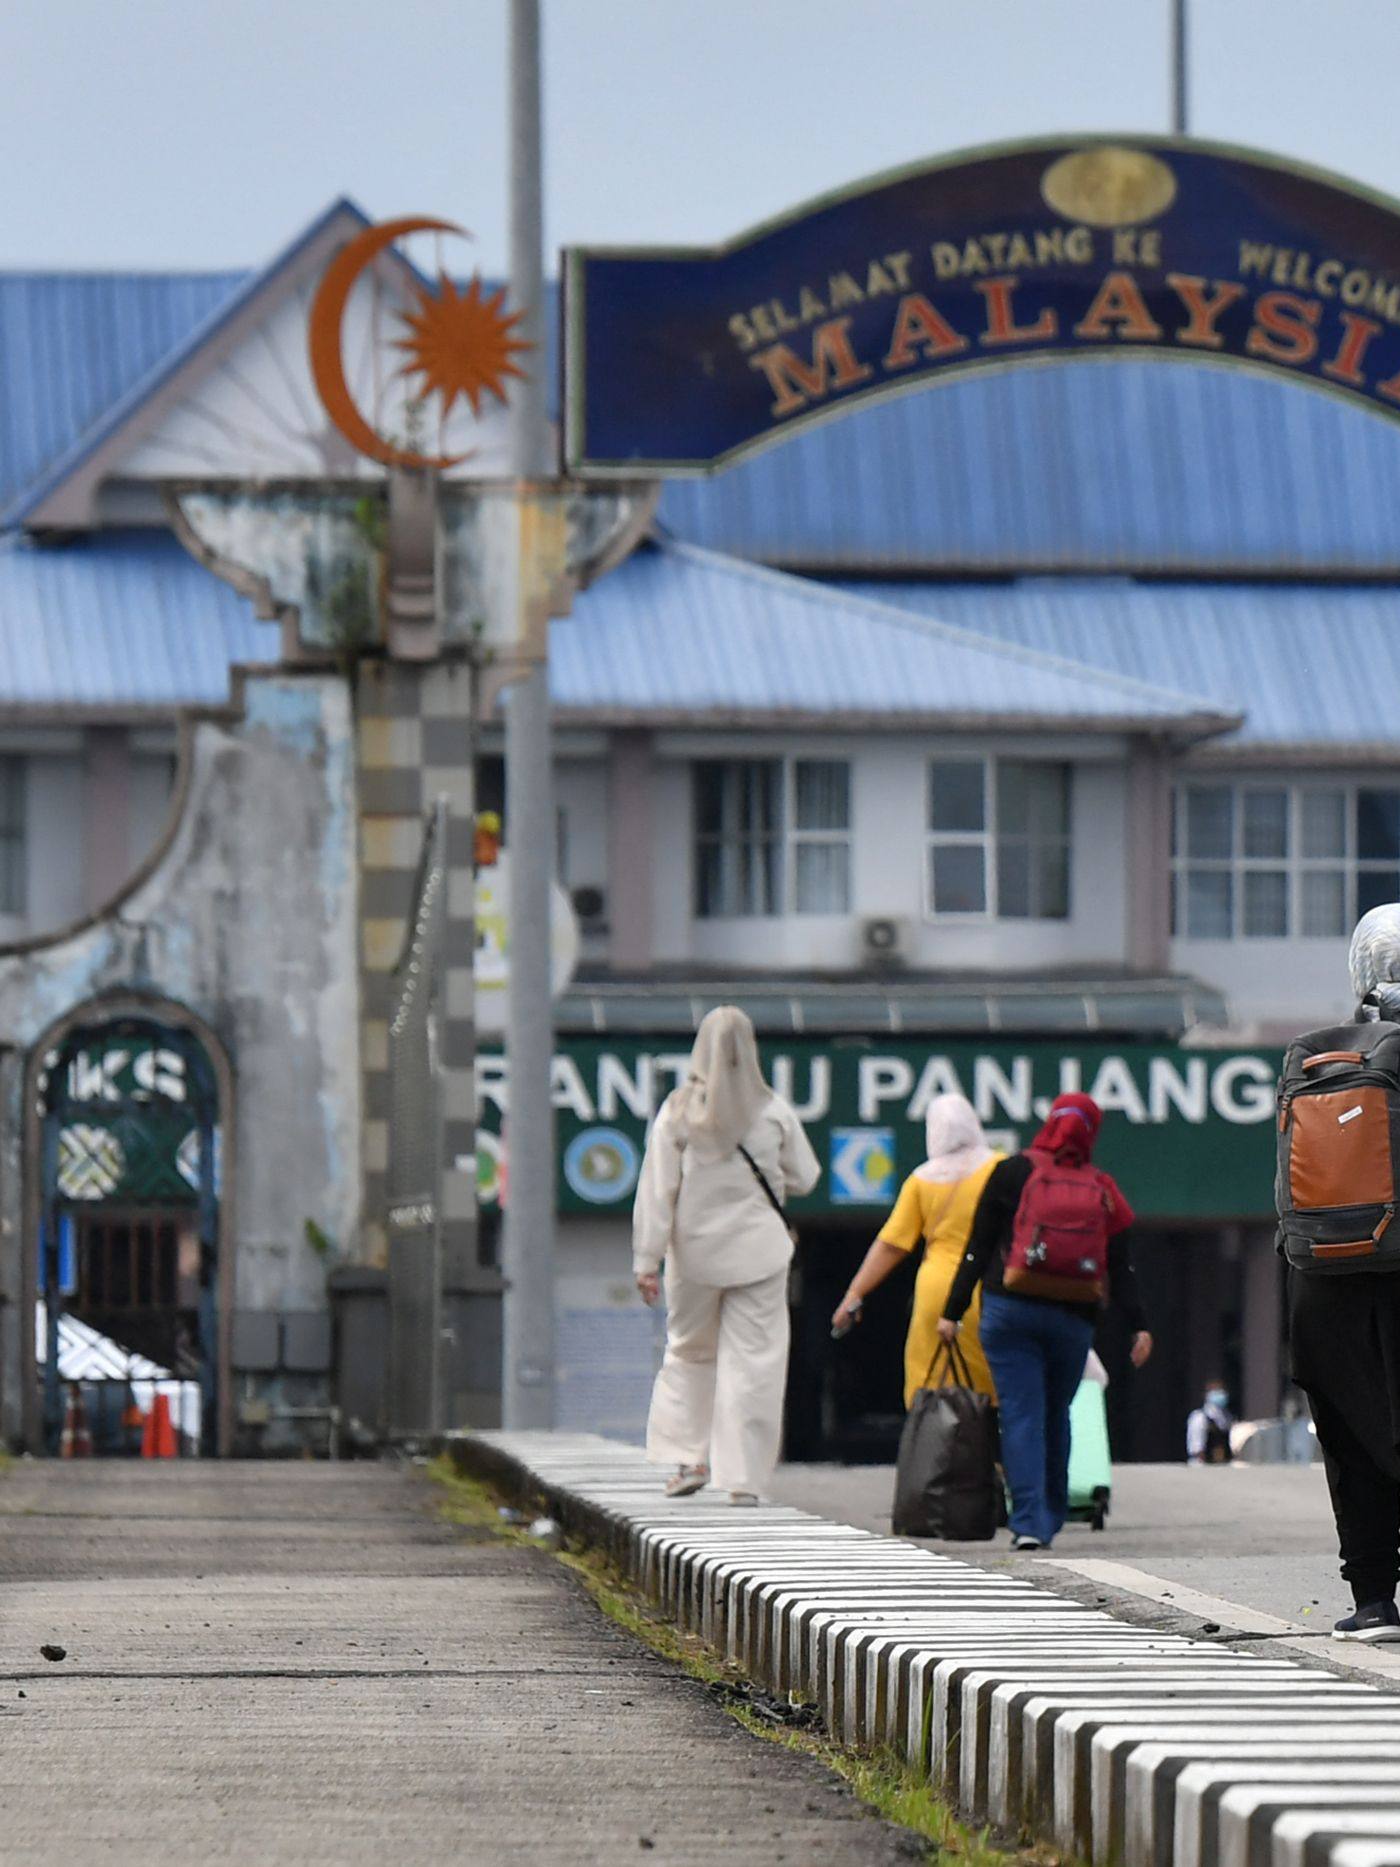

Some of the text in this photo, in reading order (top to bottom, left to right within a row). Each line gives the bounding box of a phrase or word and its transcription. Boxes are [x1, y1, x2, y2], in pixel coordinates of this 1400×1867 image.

[728, 250, 914, 350] SELAMAT
[931, 227, 1092, 279] DATANG
[1111, 228, 1162, 267] KE
[858, 1055, 1277, 1124] PANJANG
